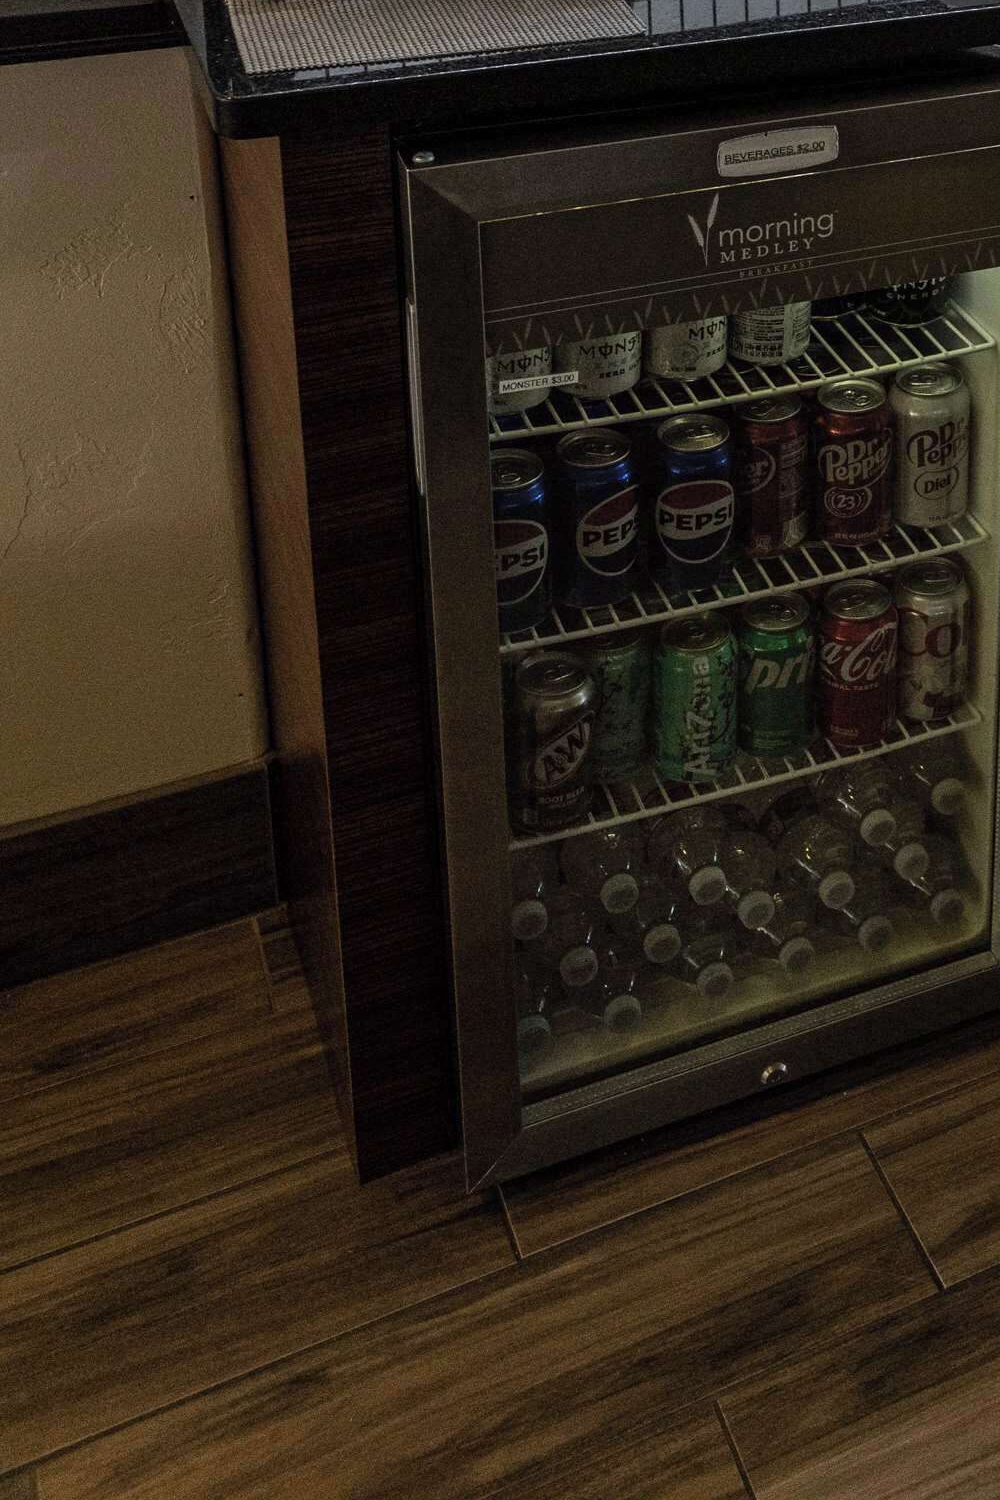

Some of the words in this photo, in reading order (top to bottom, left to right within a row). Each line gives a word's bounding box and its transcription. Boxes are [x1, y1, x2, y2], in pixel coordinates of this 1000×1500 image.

[724, 145, 794, 165] BEVERAGES
[796, 140, 826, 154] $2.00
[718, 211, 835, 248] morning
[719, 237, 814, 264] MEDLEY
[739, 259, 815, 278] BREAKFAST
[502, 378, 549, 392] MONSTER
[551, 373, 576, 385] $3.00
[924, 475, 952, 494] Diet
[835, 493, 856, 510] 23
[659, 503, 733, 532] PEPSI
[853, 682, 880, 691] TASTE
[544, 720, 593, 783] A&W
